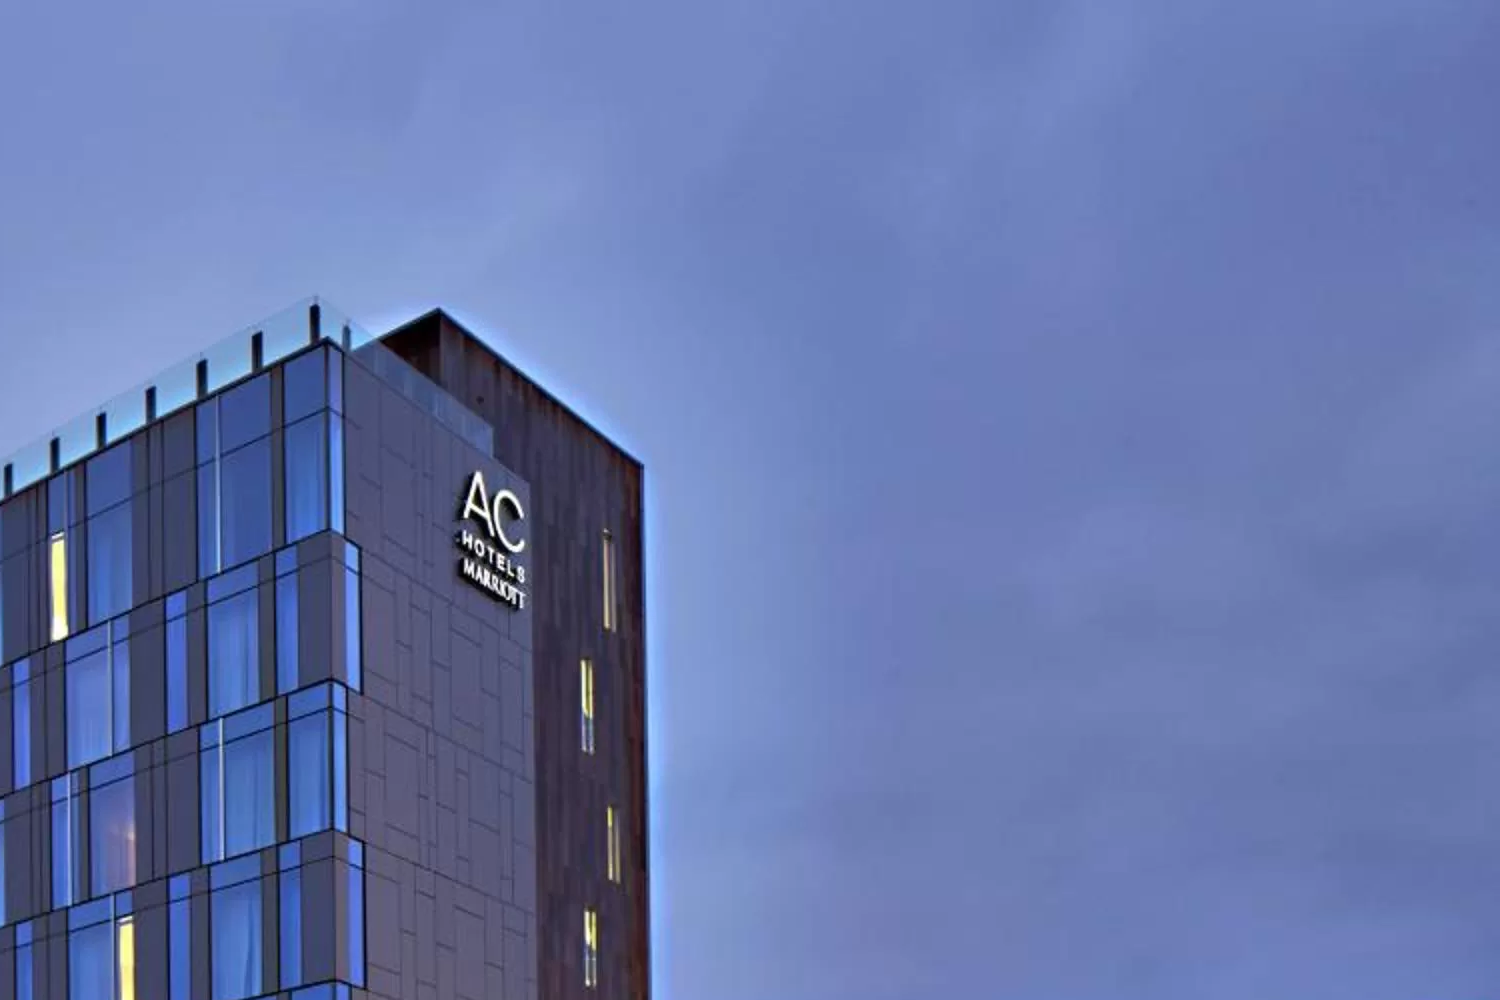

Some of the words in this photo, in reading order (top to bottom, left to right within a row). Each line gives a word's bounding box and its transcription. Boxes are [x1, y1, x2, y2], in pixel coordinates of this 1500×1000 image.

[463, 471, 525, 553] AC
[462, 530, 525, 583] HOTELS
[463, 558, 526, 609] MARRIOTT
